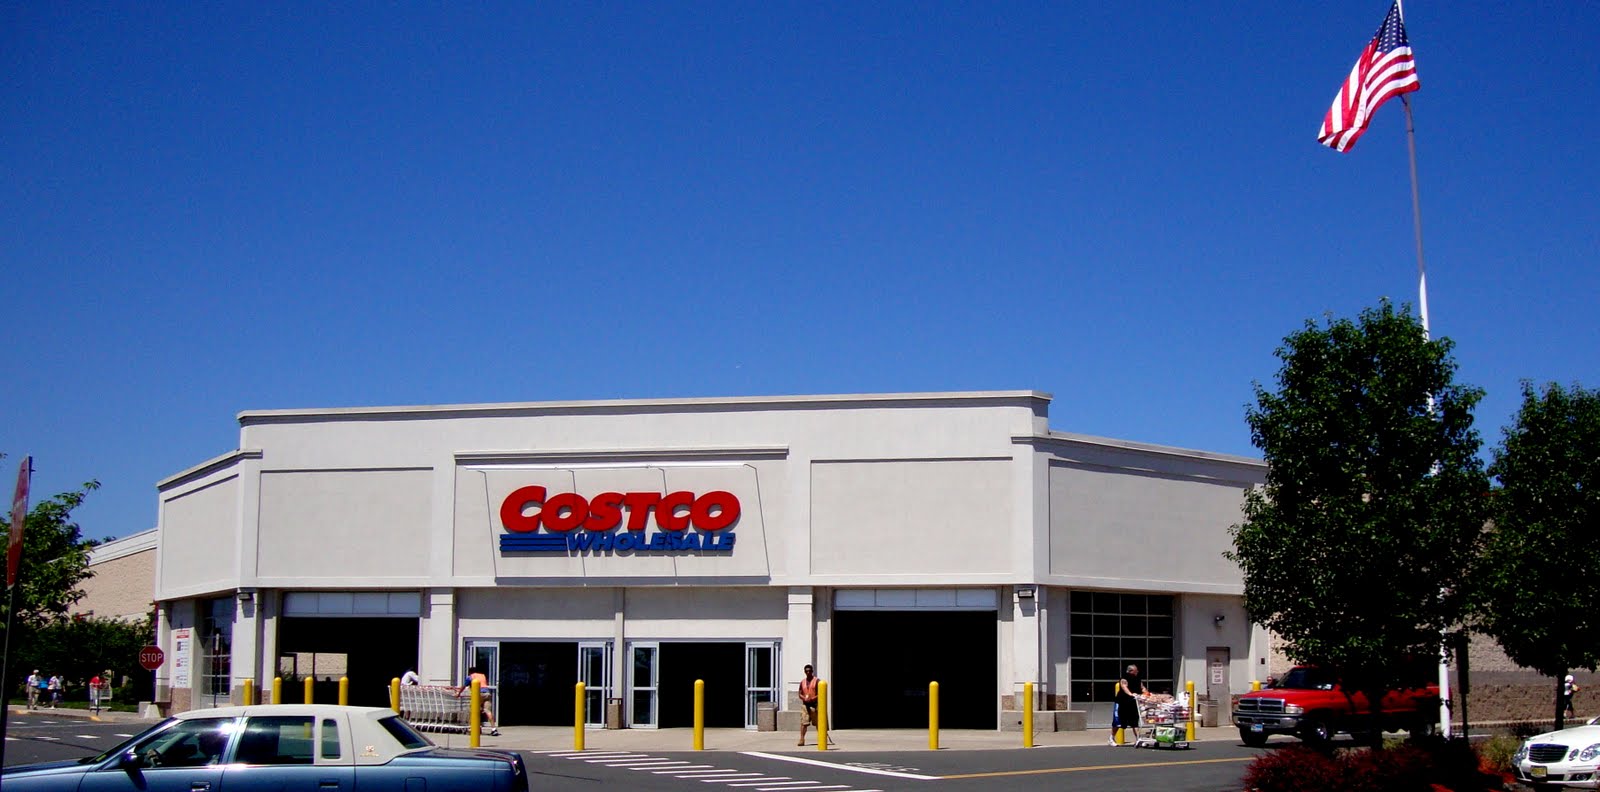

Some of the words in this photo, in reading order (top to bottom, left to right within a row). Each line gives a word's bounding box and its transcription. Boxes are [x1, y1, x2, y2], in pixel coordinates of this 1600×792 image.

[500, 485, 742, 534] COSTCO
[566, 532, 736, 553] WHOLESALE
[141, 652, 163, 663] STOP
